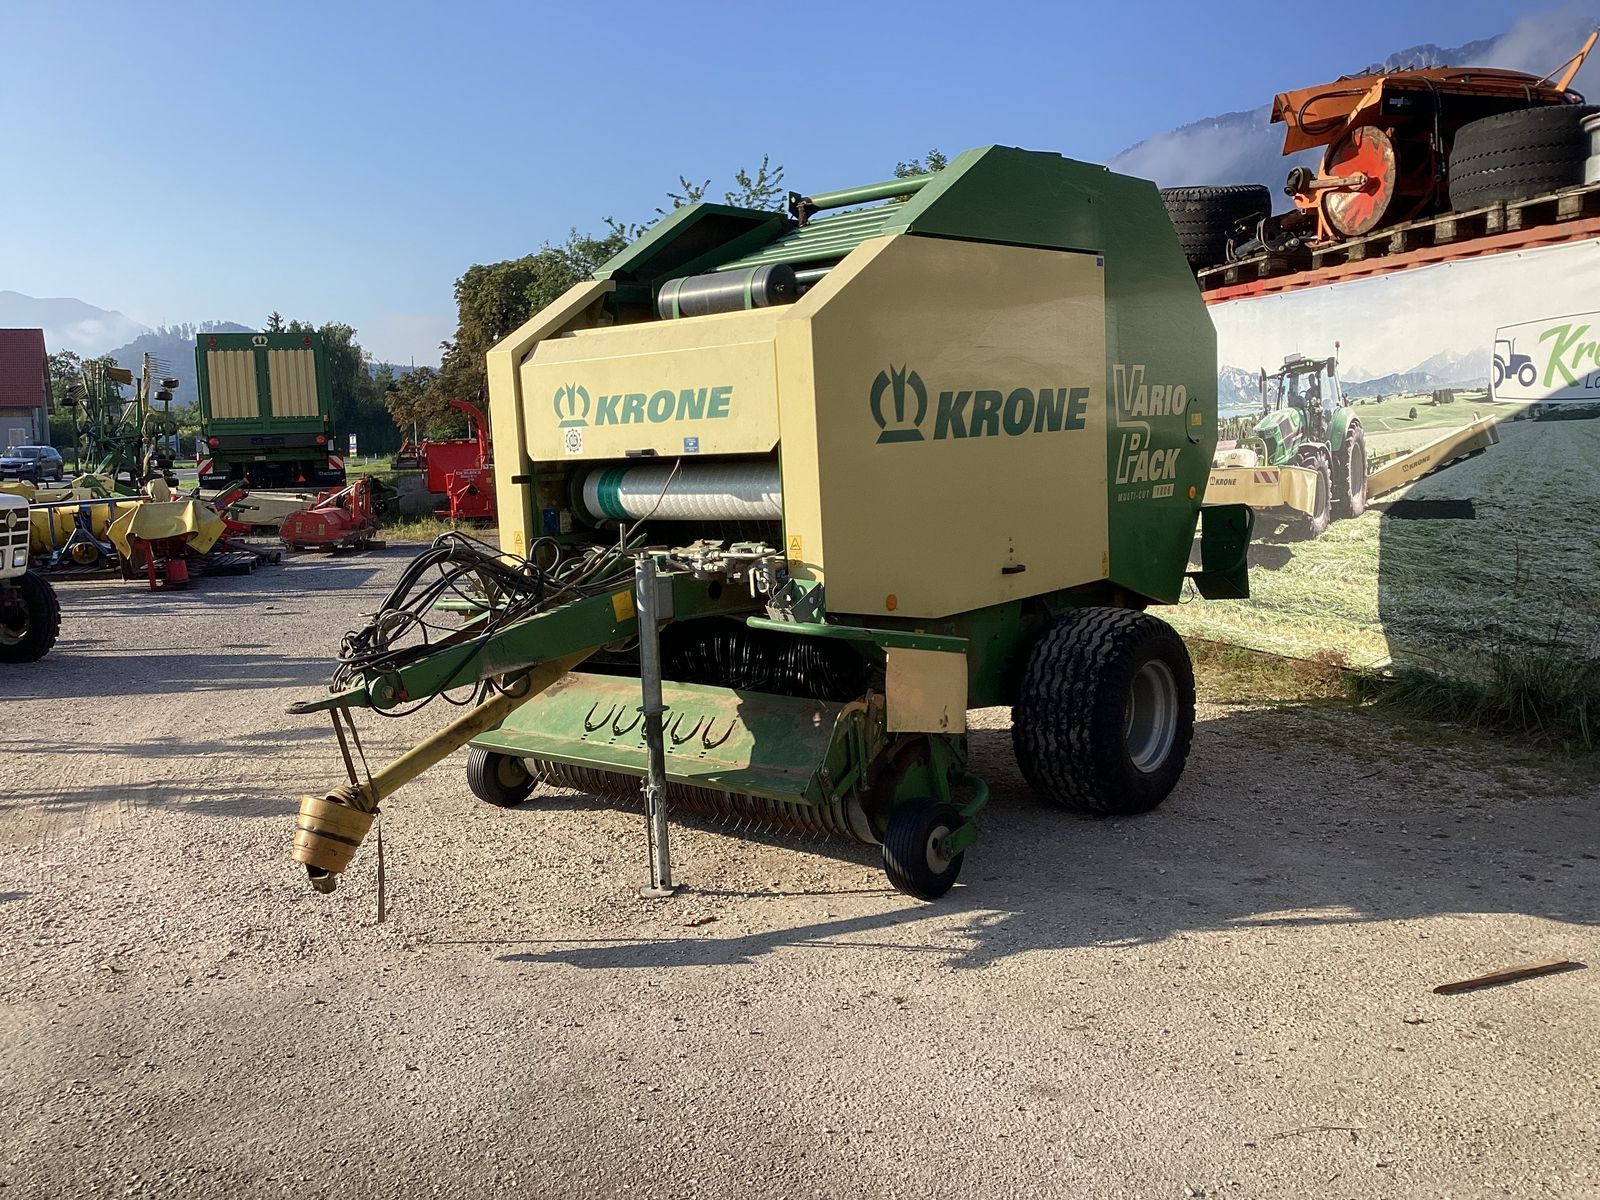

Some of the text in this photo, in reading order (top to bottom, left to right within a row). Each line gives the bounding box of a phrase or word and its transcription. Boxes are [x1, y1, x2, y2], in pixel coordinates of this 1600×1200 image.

[594, 385, 733, 426] KRONE
[933, 387, 1090, 440] KRONE
[1113, 364, 1187, 417] VARIO
[1115, 421, 1181, 485] PACK
[1409, 454, 1431, 470] KRONE
[1215, 478, 1237, 486] KRONE
